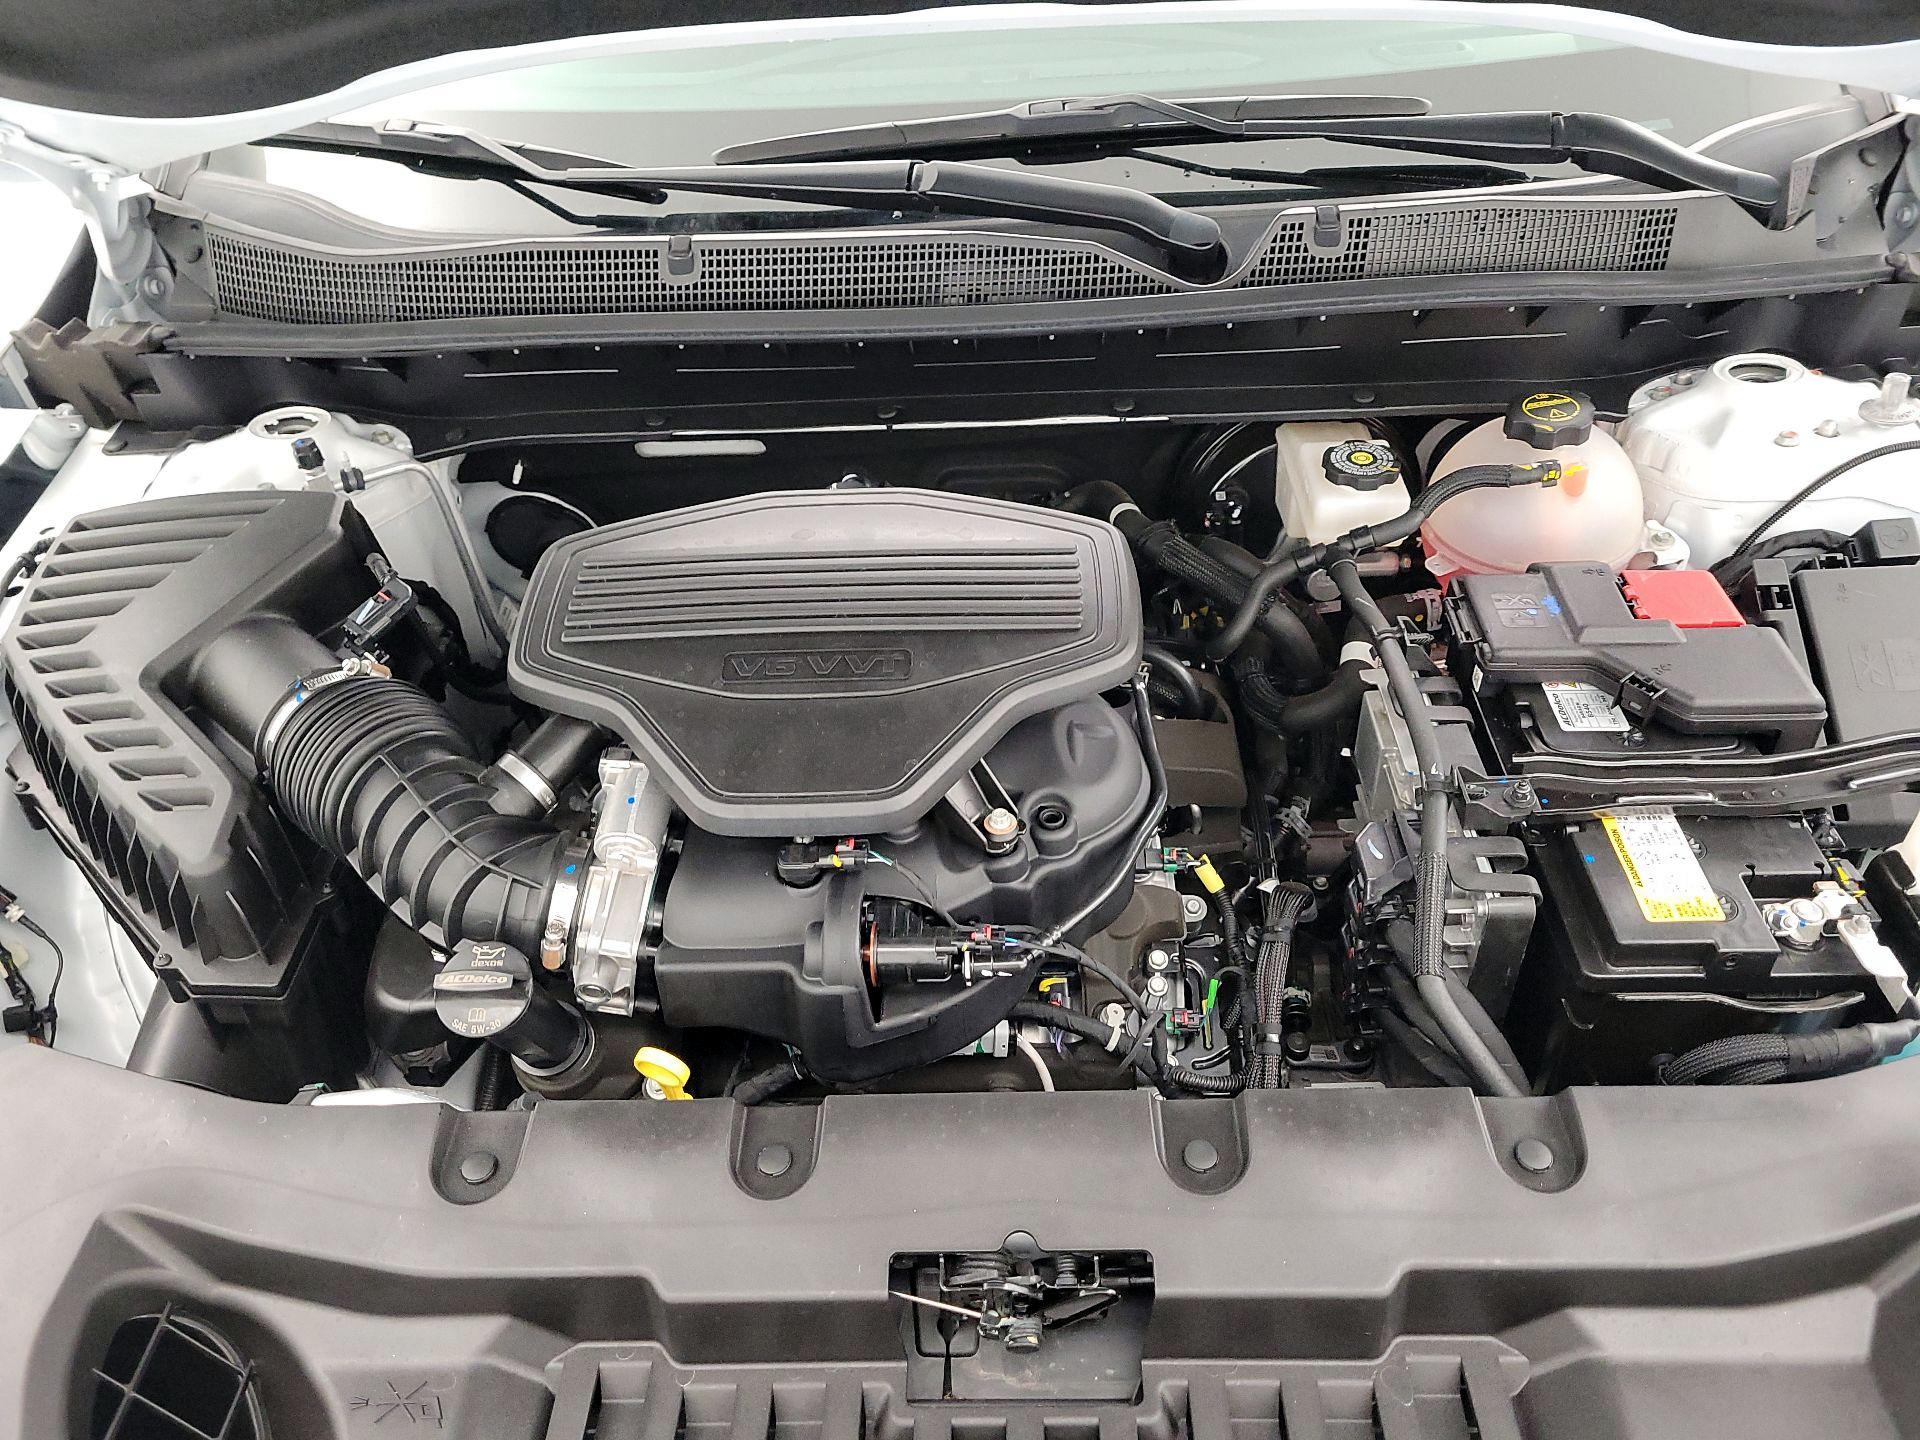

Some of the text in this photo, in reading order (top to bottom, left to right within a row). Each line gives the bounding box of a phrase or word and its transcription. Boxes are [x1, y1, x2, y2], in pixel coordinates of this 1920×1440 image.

[731, 653, 905, 676] V6 VVT
[441, 974, 508, 984] ACDelco
[451, 1018, 502, 1034] SAE 5W-30
